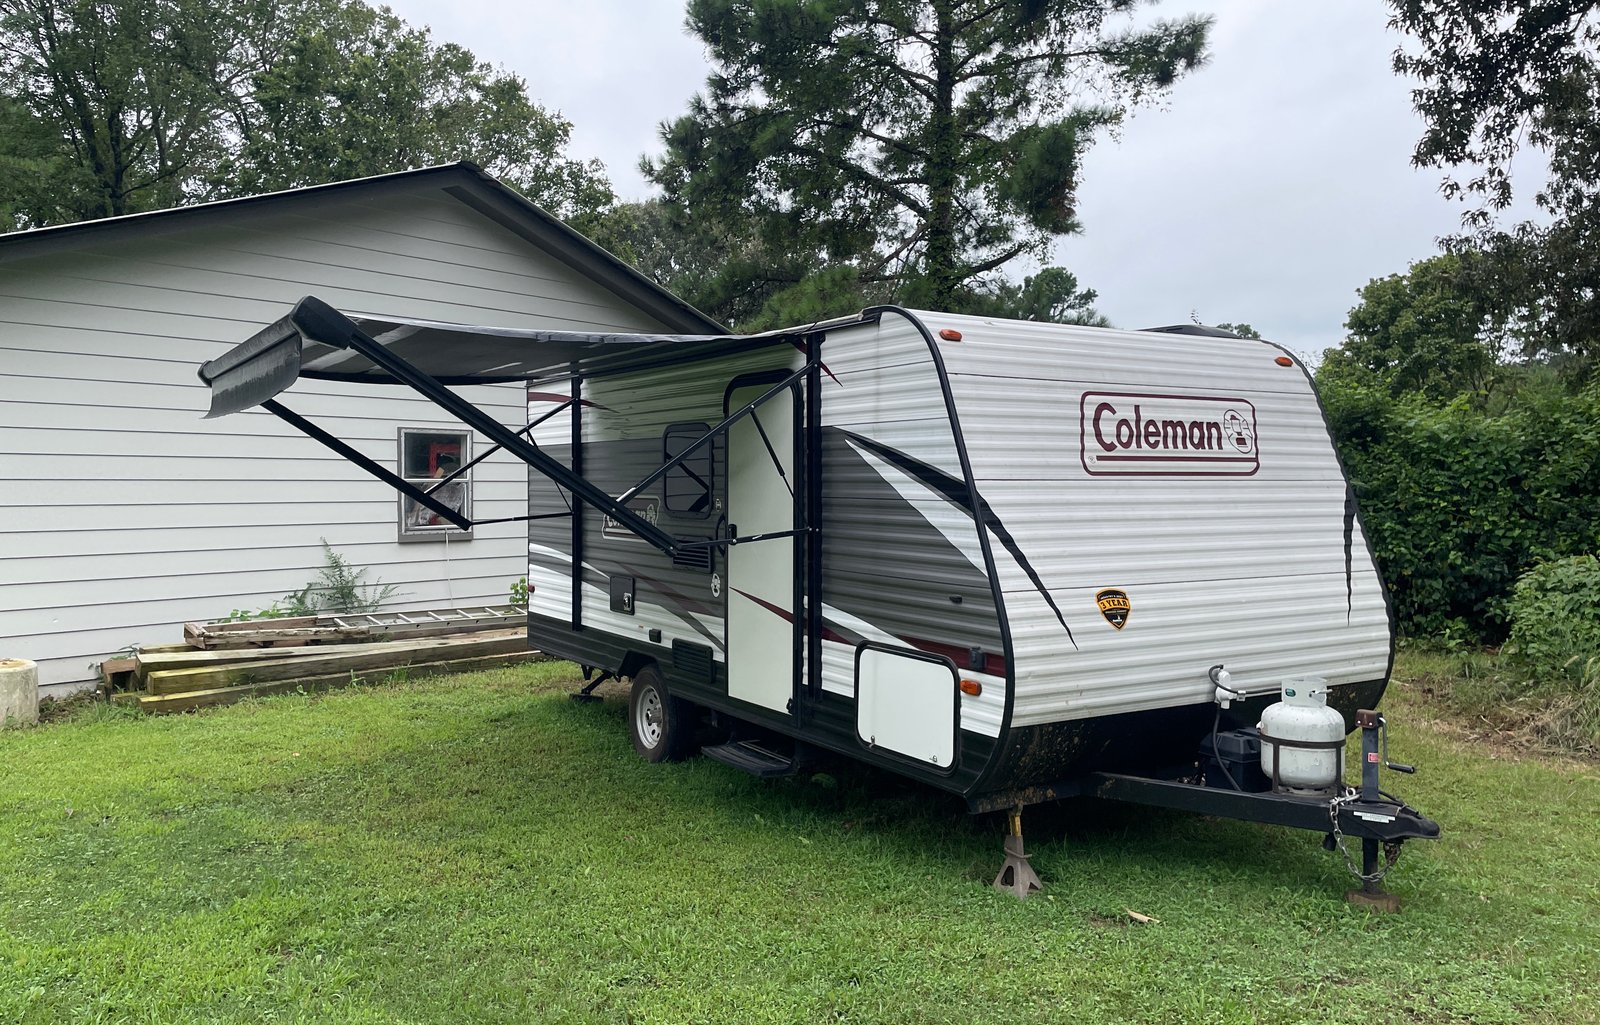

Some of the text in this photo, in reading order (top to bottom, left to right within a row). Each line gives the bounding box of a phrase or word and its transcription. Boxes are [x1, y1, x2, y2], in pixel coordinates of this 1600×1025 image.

[1093, 402, 1223, 452] Coleman
[1100, 600, 1128, 609] 3 YEAR
